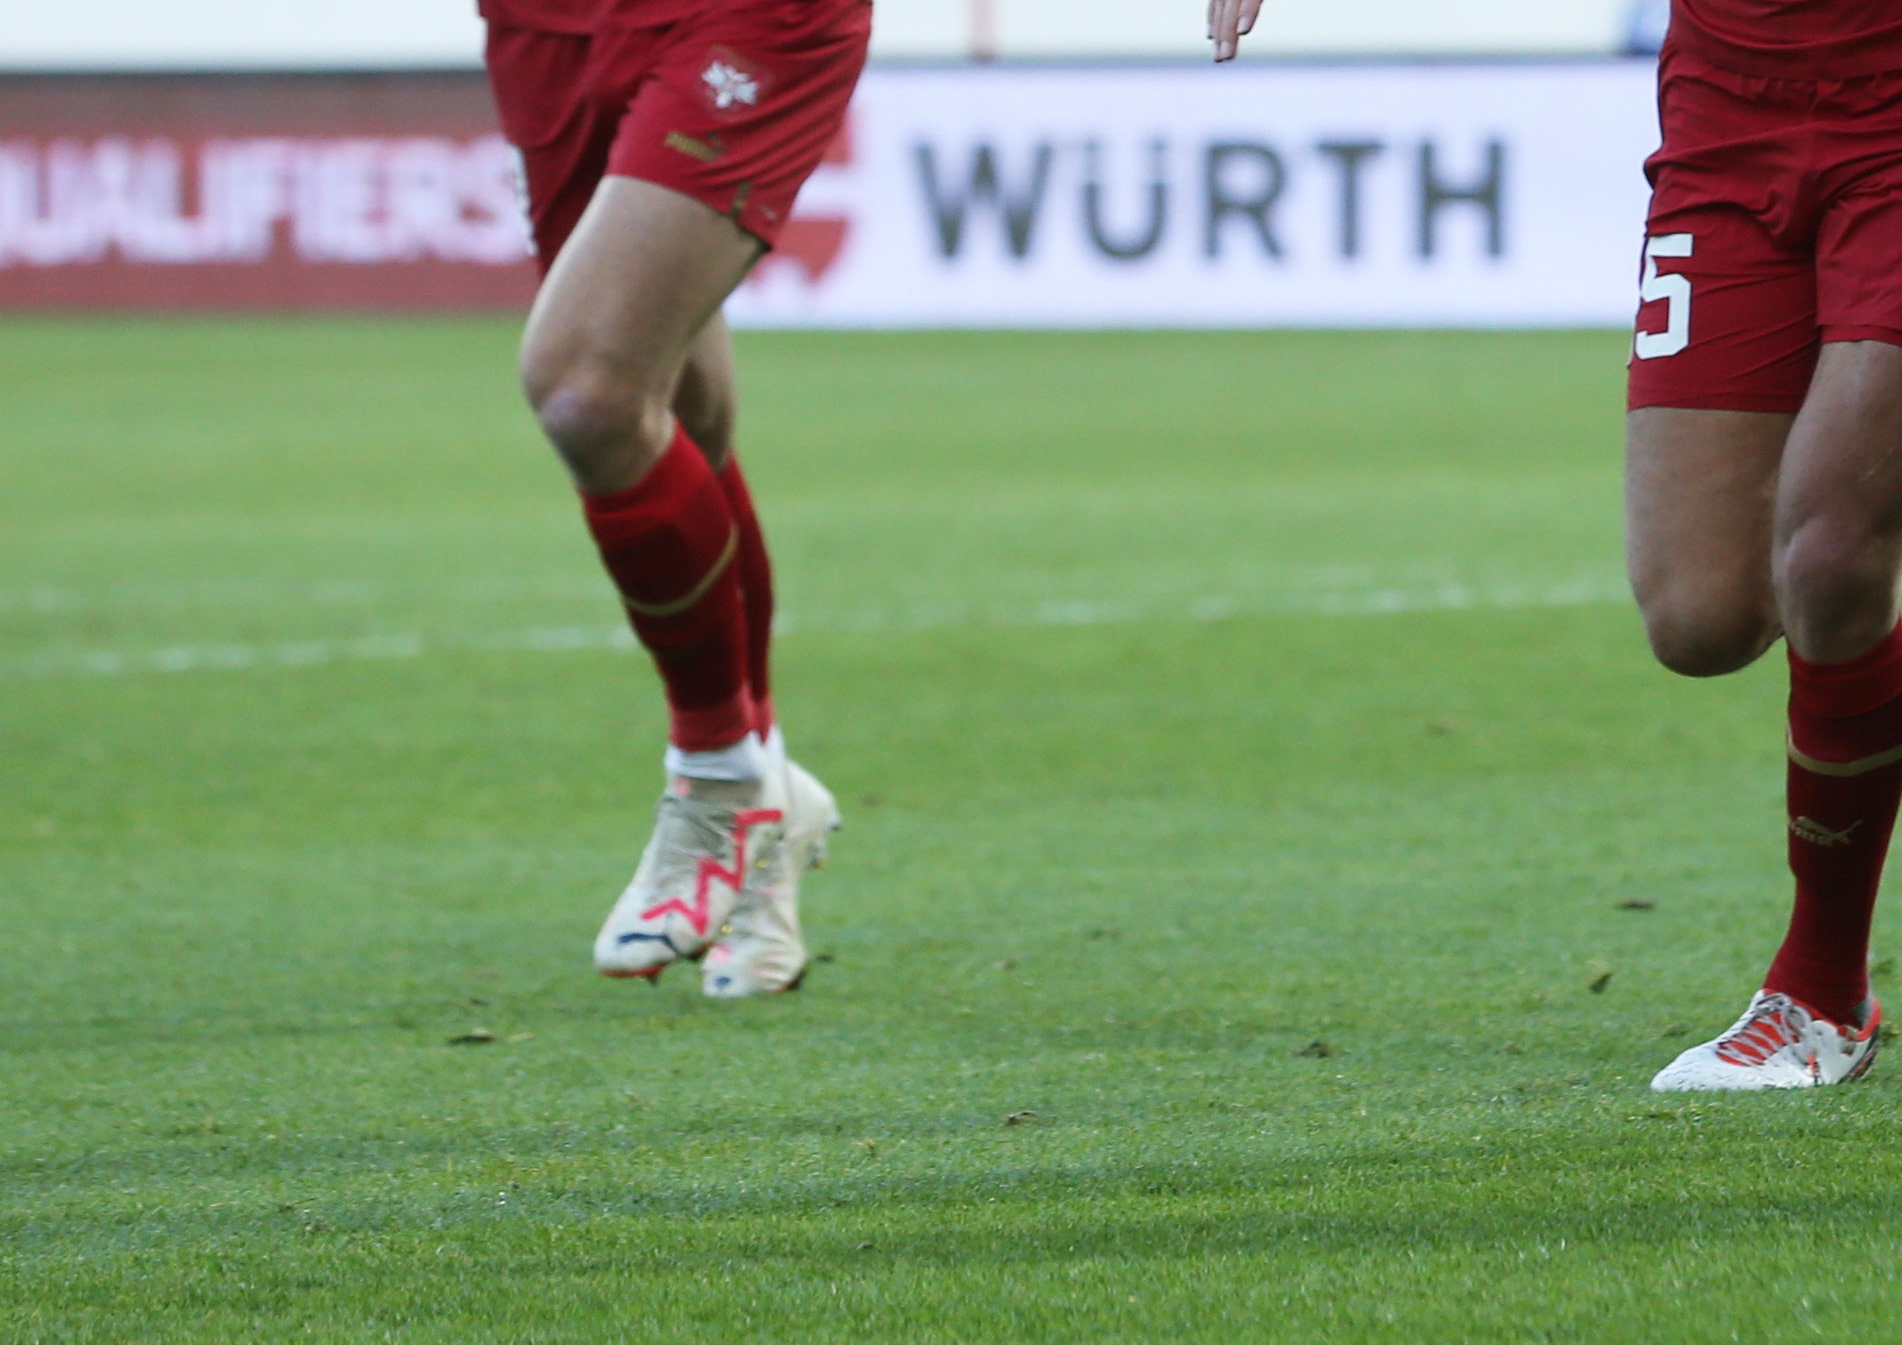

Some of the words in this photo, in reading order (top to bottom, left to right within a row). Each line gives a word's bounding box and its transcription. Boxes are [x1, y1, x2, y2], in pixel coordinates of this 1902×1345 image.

[0, 135, 534, 265] UALIFIERS
[910, 138, 1508, 262] WÜRTH
[1635, 232, 1693, 361] 5
